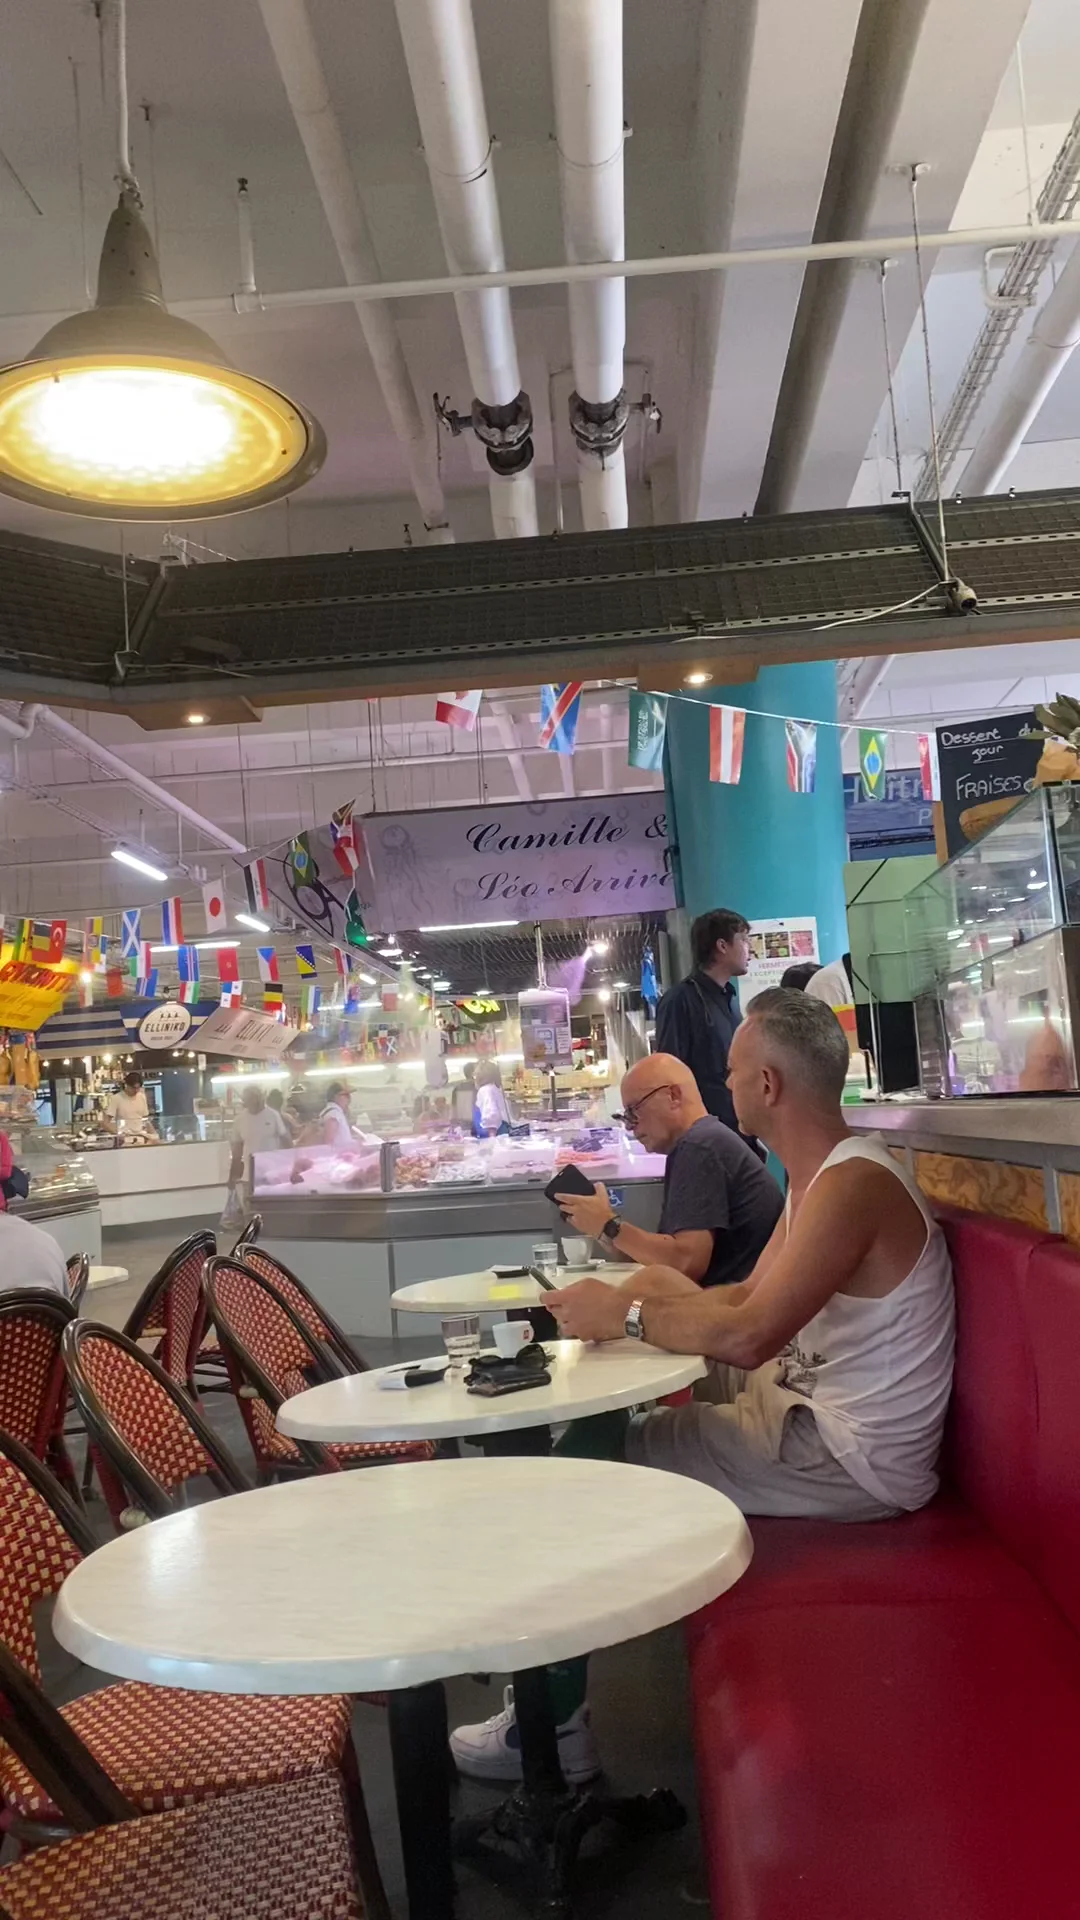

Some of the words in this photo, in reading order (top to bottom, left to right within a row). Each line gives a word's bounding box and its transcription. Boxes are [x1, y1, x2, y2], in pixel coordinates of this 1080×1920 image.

[941, 728, 1002, 746] Dessert
[466, 815, 631, 852] Camille
[645, 813, 668, 838] &
[478, 872, 539, 900] Léo
[144, 1021, 186, 1033] ELLINIKO
